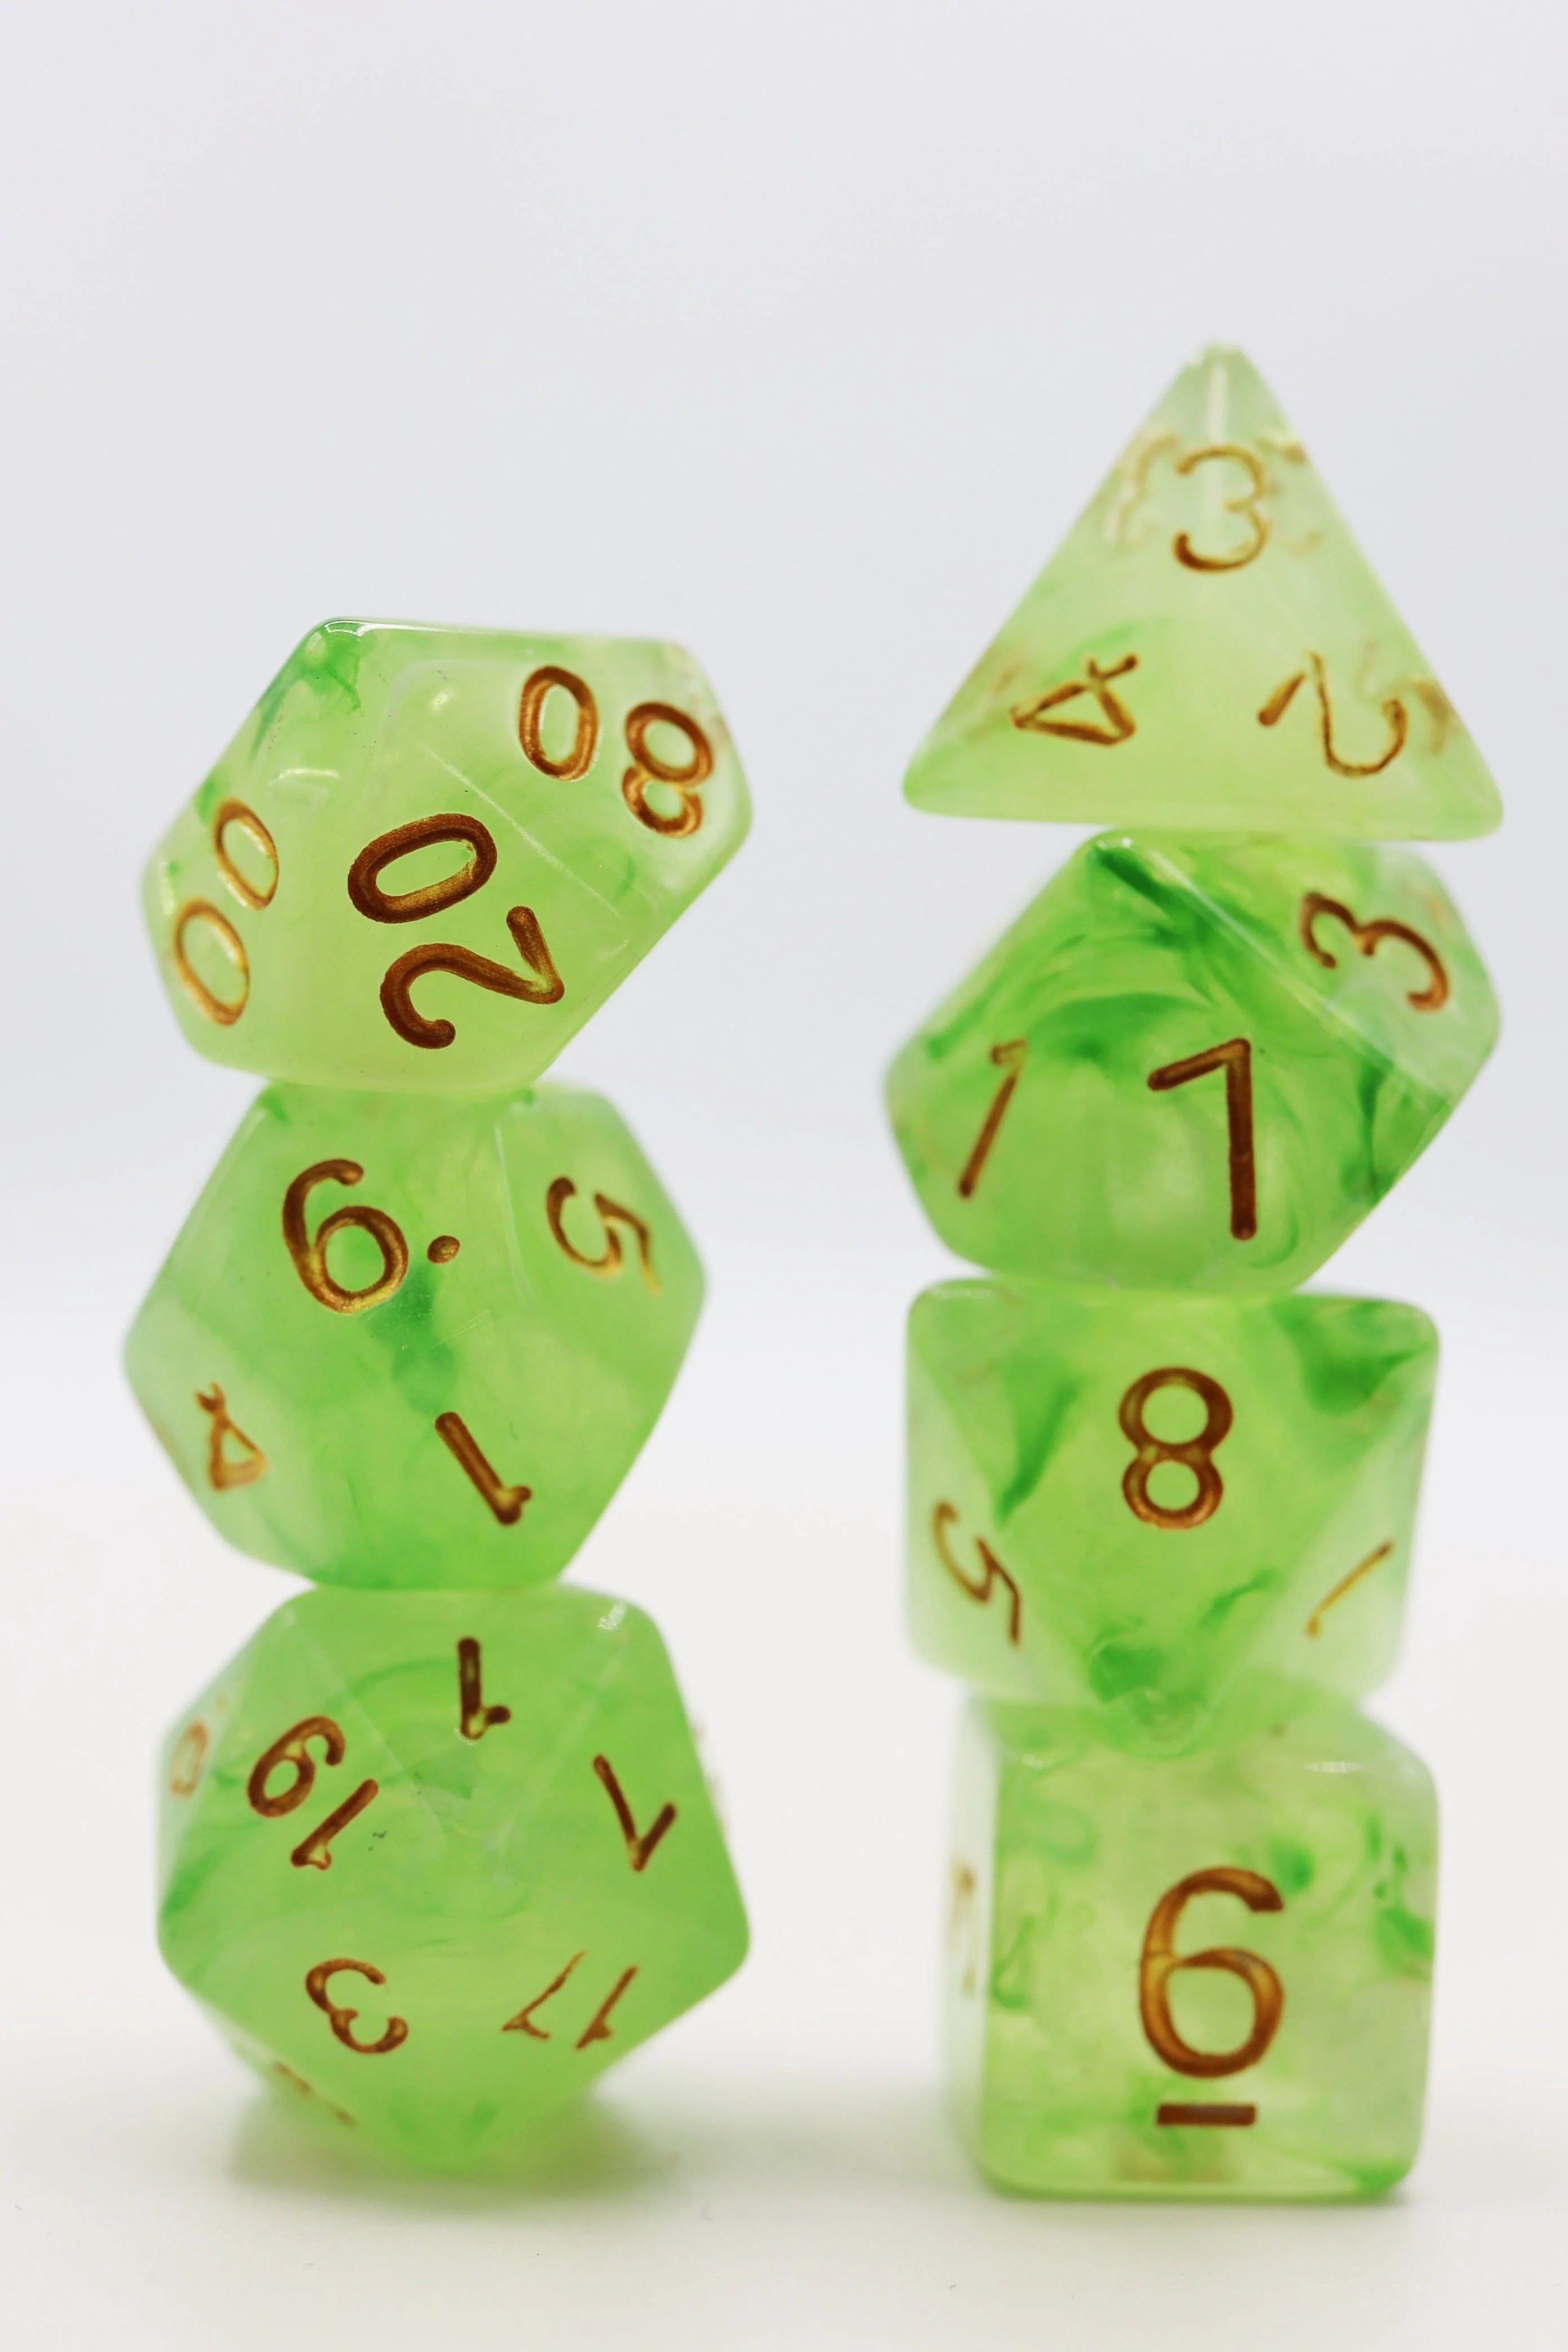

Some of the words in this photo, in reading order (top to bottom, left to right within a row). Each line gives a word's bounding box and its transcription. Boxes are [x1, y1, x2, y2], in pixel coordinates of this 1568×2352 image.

[1173, 445, 1269, 575] 3
[1010, 654, 1139, 748] 4
[1256, 648, 1410, 778] 2
[347, 813, 565, 1049] 20
[1299, 893, 1450, 1013] 3
[546, 1176, 663, 1295] 5
[194, 1381, 269, 1493] 4
[435, 1412, 532, 1525] 1
[1118, 1366, 1234, 1530] 8
[932, 1499, 1023, 1648] 5
[457, 1636, 511, 1740] 1
[247, 1715, 379, 1872] 19
[304, 1957, 409, 2055] 3
[501, 1950, 639, 2051] 17
[1137, 1865, 1286, 2078] 6
